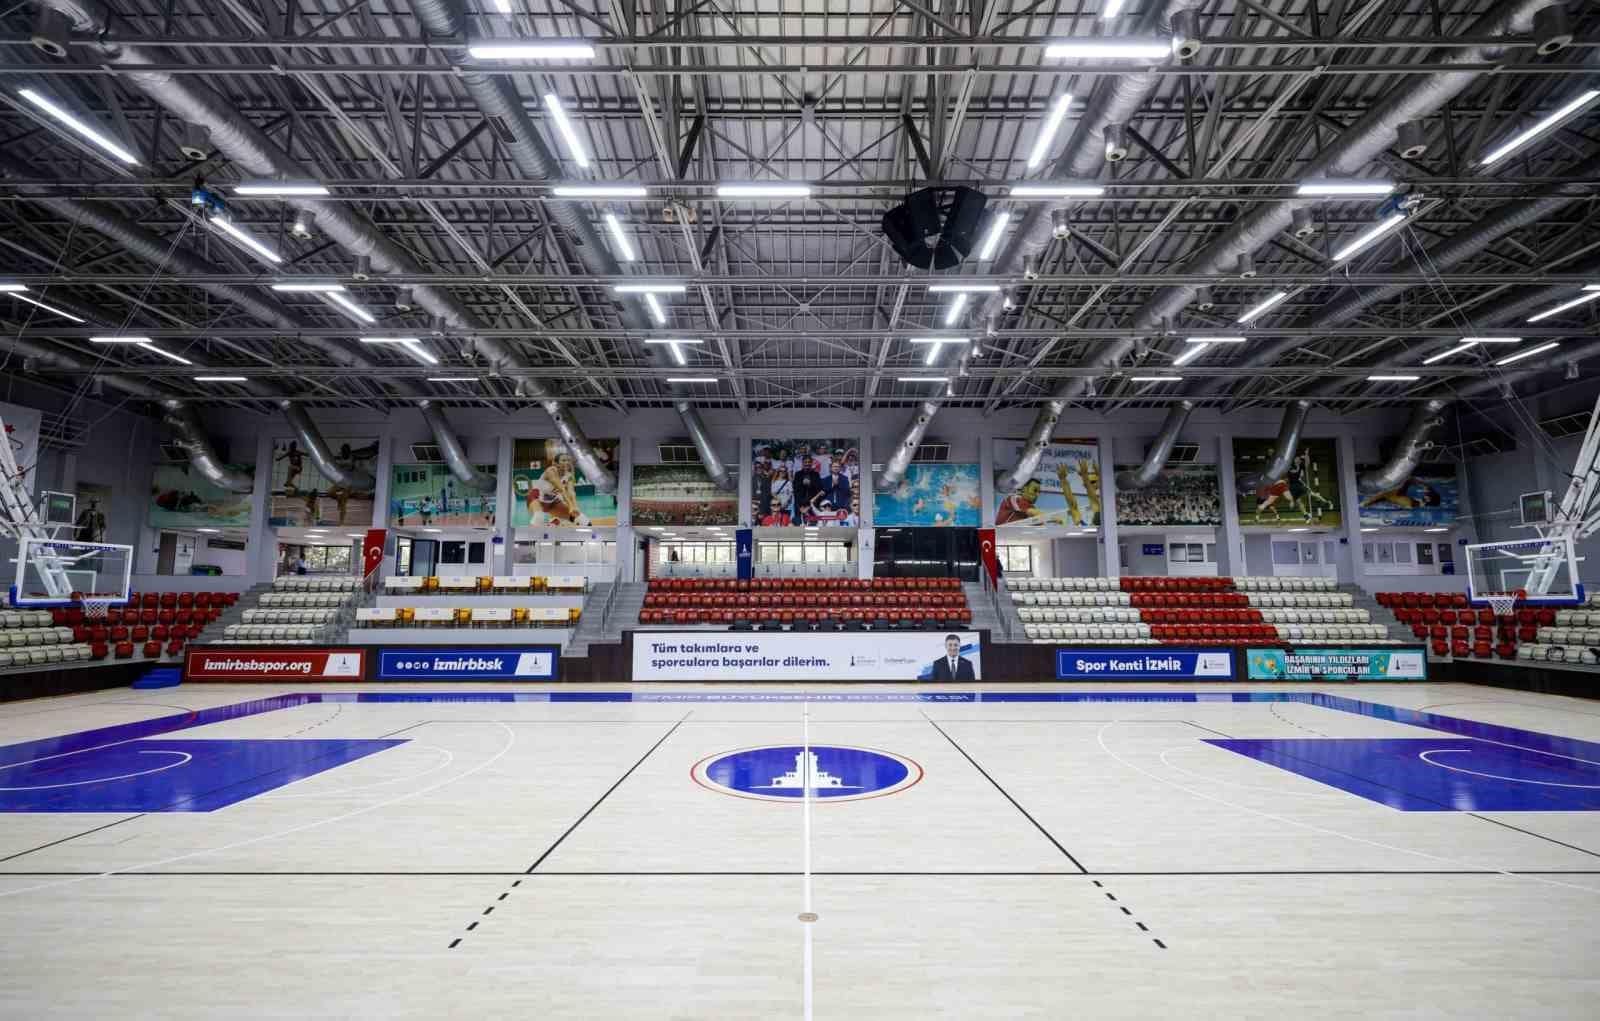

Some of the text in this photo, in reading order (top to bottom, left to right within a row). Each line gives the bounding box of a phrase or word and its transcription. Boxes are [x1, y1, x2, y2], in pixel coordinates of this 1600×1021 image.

[652, 642, 759, 653] Tüm takımlara ve
[204, 658, 312, 673] izmirbsbspor.org
[433, 658, 504, 671] izmirbbsk
[652, 656, 831, 669] sporculara başarılar dilerim.
[1076, 657, 1181, 673] Spor Kenti İZMİR
